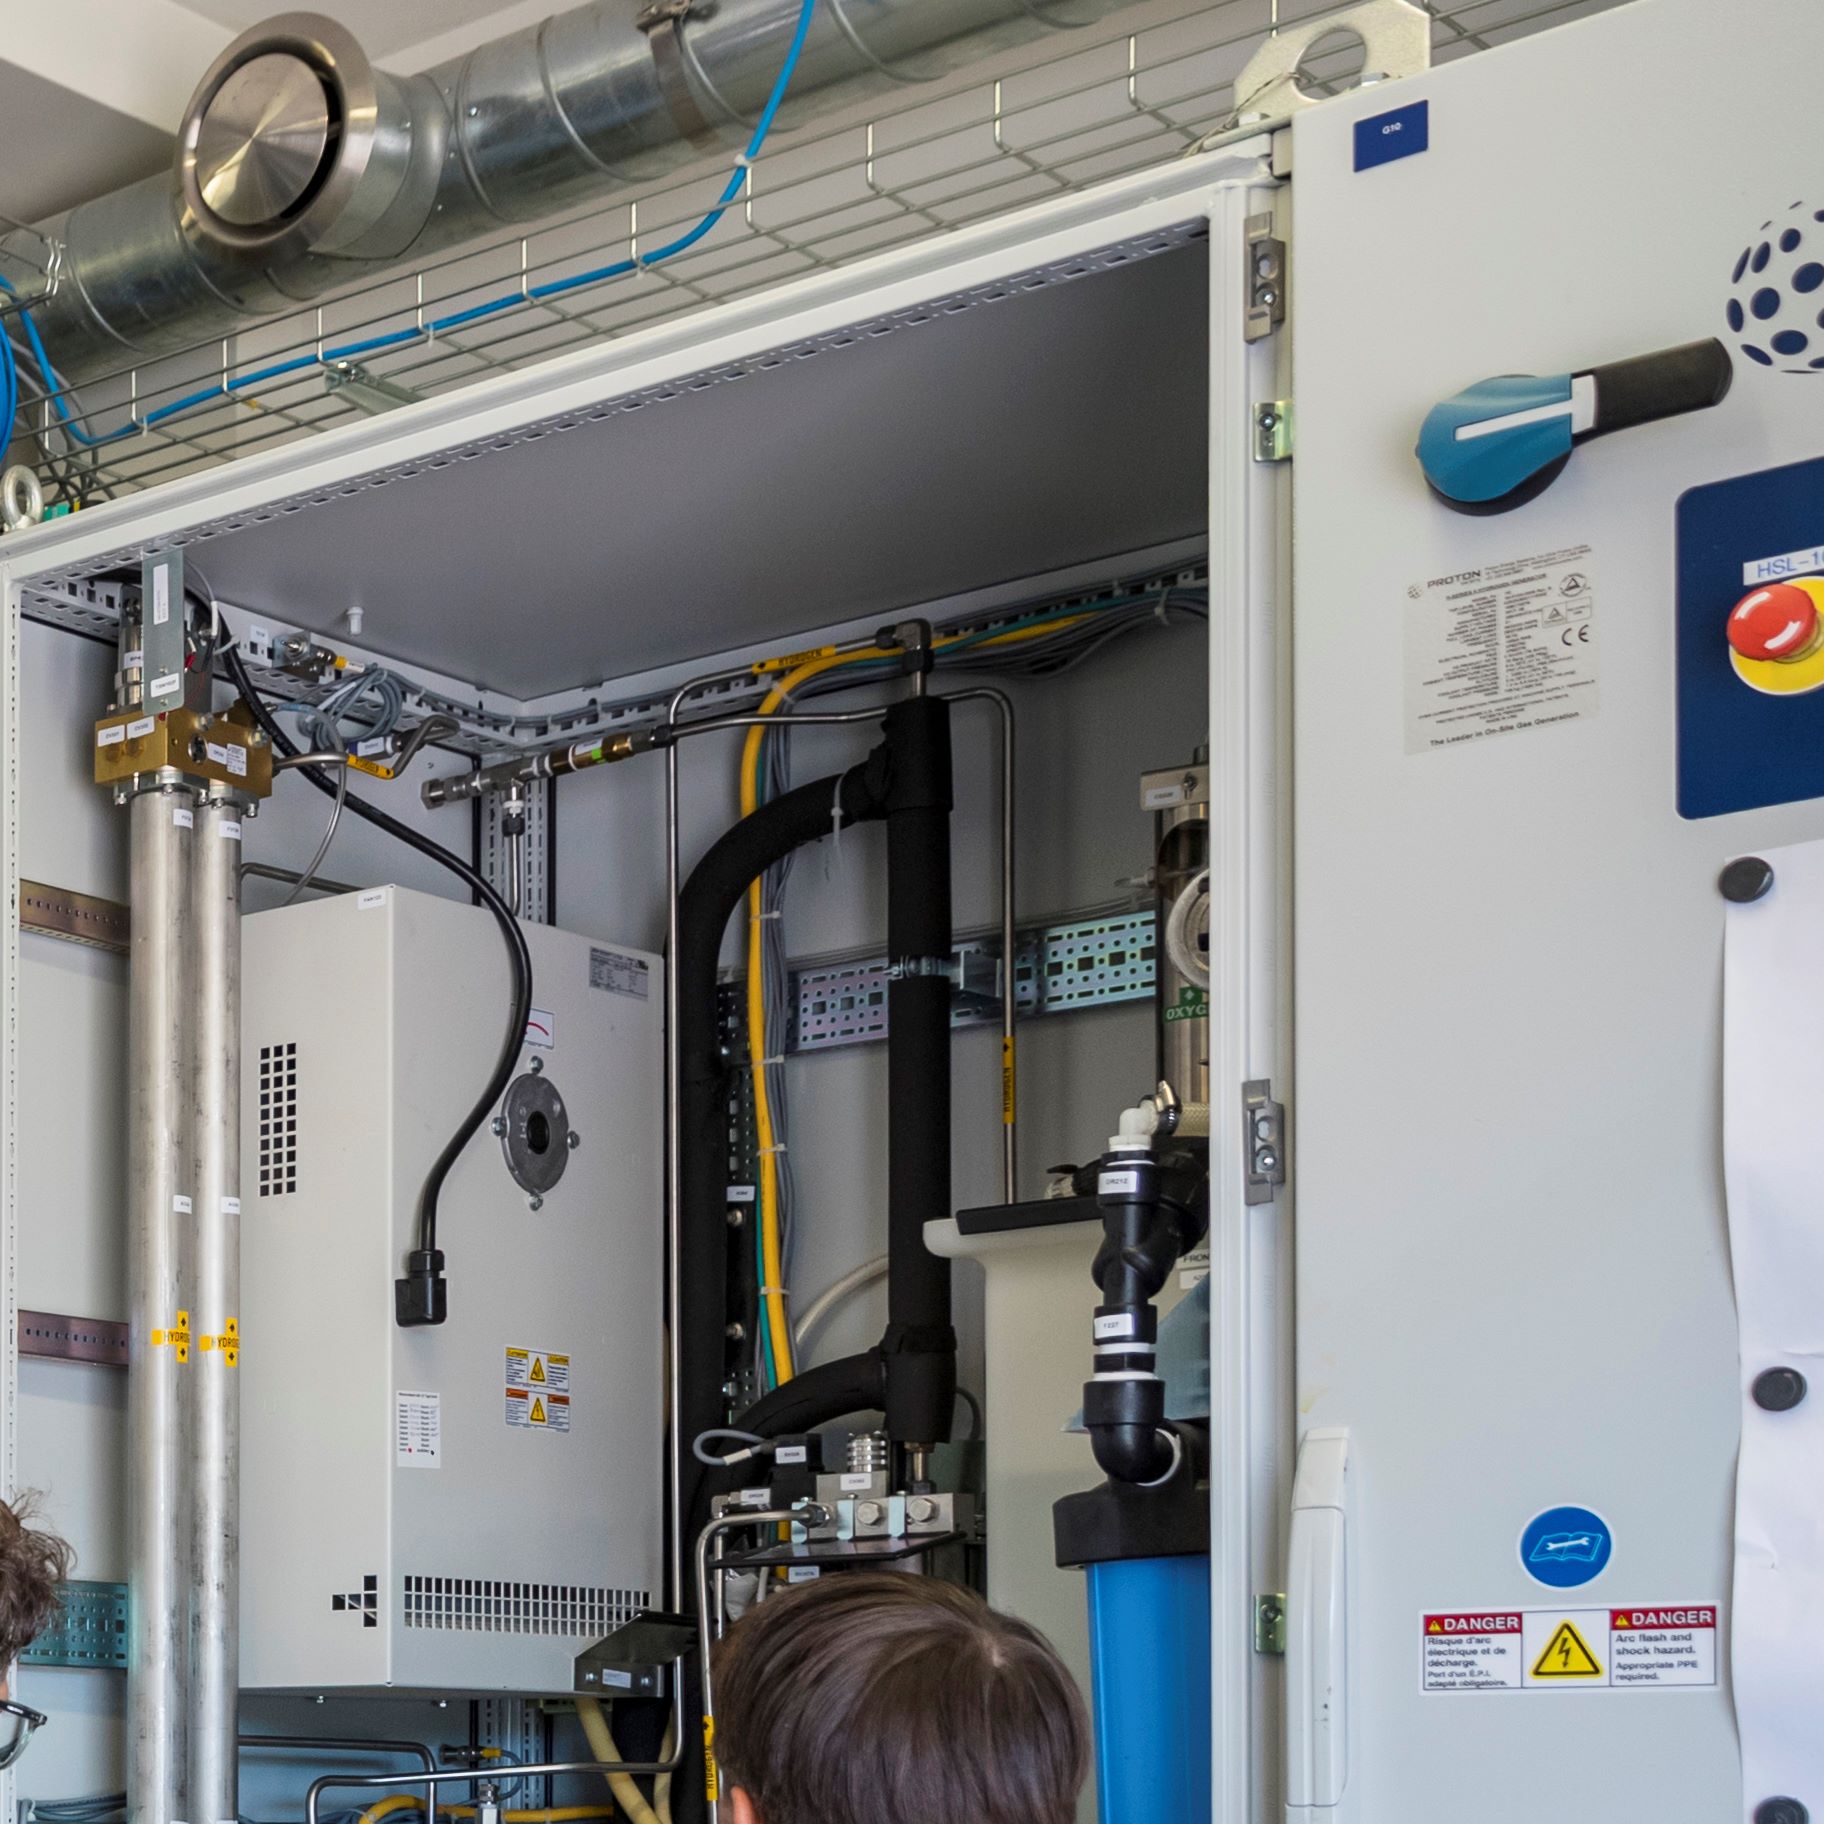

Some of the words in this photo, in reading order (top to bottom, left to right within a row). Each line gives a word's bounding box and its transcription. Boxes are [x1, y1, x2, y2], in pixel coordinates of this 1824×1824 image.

[1426, 570, 1482, 589] PROTON
[1430, 738, 1444, 747] The
[1446, 732, 1474, 744] Leader
[1484, 724, 1514, 736] On-Site
[1516, 720, 1532, 730] Gas
[1534, 711, 1580, 726] Generation
[1444, 1616, 1520, 1632] DANGER
[1632, 1610, 1713, 1626] DANGER
[1427, 1636, 1464, 1646] Risque
[1466, 1636, 1492, 1645] d'arc
[1615, 1633, 1636, 1642] Arc
[1638, 1632, 1668, 1642] flash
[1670, 1632, 1692, 1642] and
[1427, 1646, 1478, 1658] électrique
[1480, 1646, 1491, 1655] et
[1493, 1646, 1506, 1655] de
[1615, 1646, 1651, 1656] shock
[1653, 1644, 1696, 1655] hazard.
[1427, 1658, 1478, 1669] décharge.
[1615, 1660, 1675, 1672] Appropriate
[1676, 1659, 1698, 1668] PPE
[1427, 1670, 1446, 1678] Port
[1447, 1670, 1466, 1678] d'un
[1615, 1672, 1660, 1682] required.
